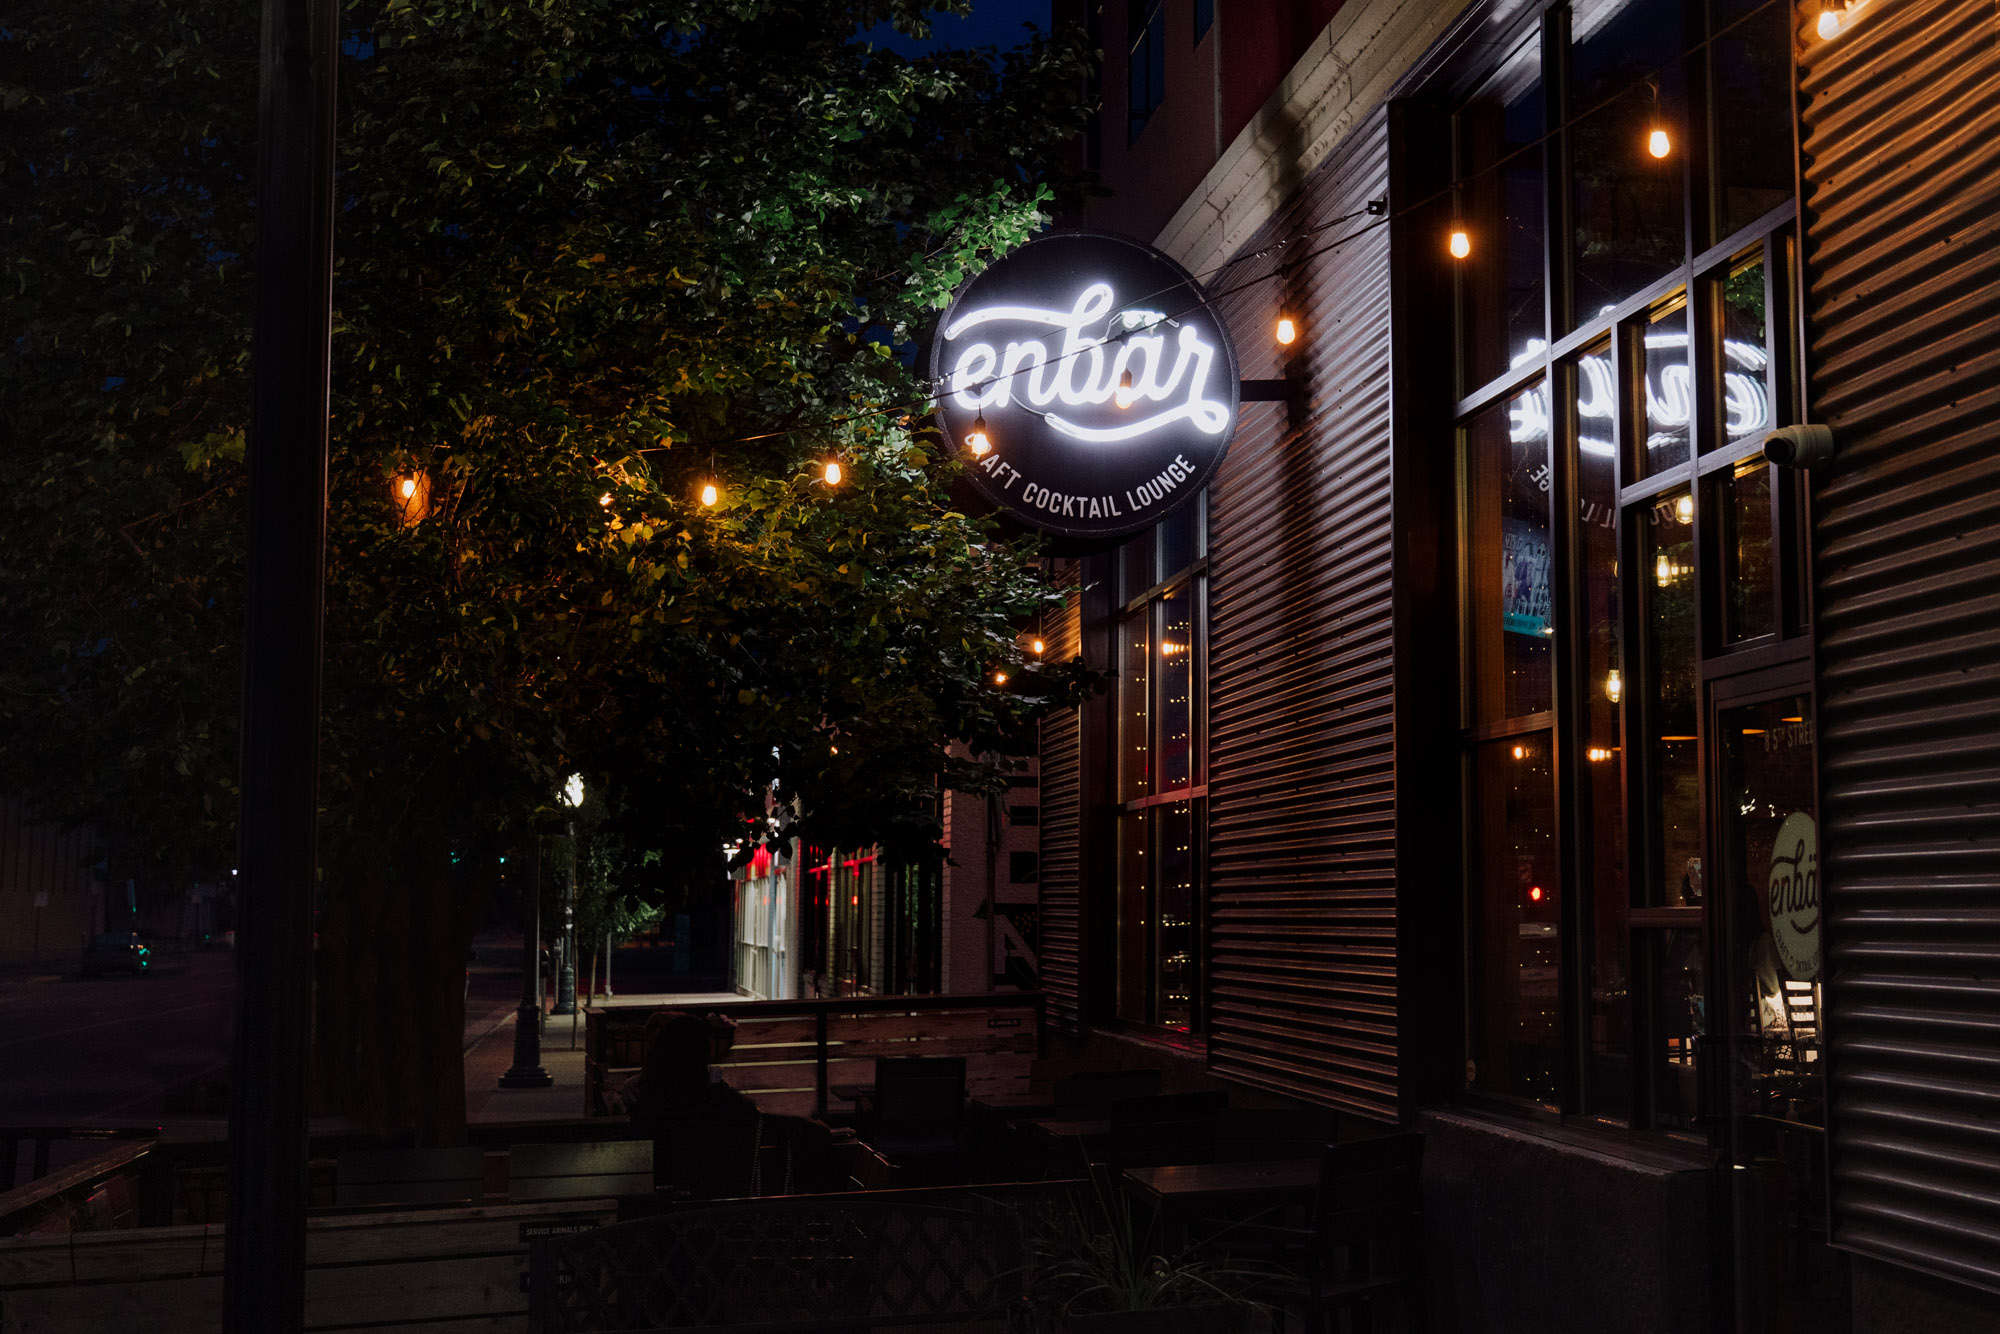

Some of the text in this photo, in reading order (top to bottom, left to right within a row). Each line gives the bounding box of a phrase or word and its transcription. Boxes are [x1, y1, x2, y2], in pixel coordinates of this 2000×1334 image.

[964, 432, 1196, 519] AFT COCKTAIL LOUNGE
[1770, 839, 1818, 934] enbä
